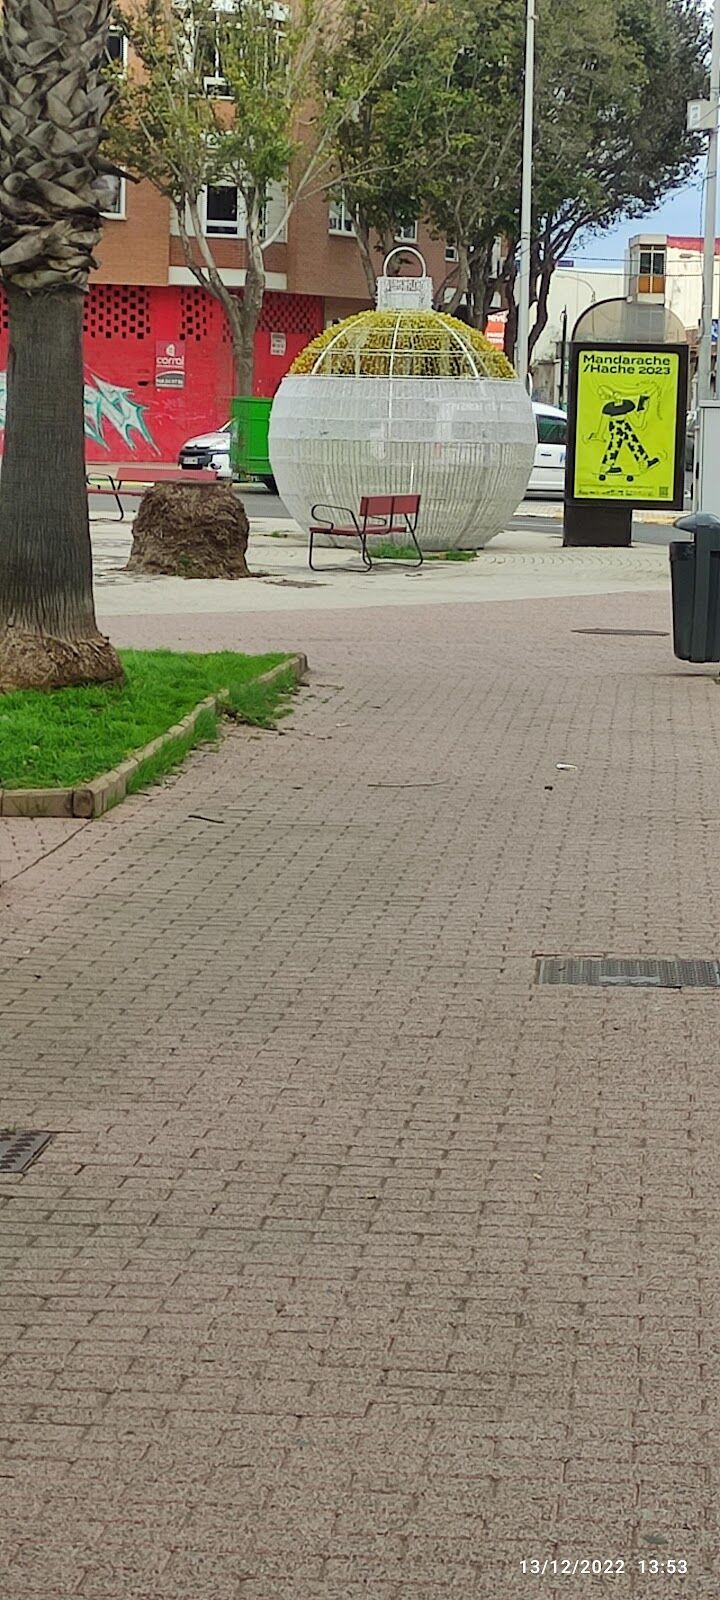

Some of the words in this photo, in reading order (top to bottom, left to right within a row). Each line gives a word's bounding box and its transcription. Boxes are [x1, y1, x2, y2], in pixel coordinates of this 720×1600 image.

[583, 354, 671, 366] Mandarache
[583, 364, 636, 375] /Hache
[638, 366, 671, 376] 2023
